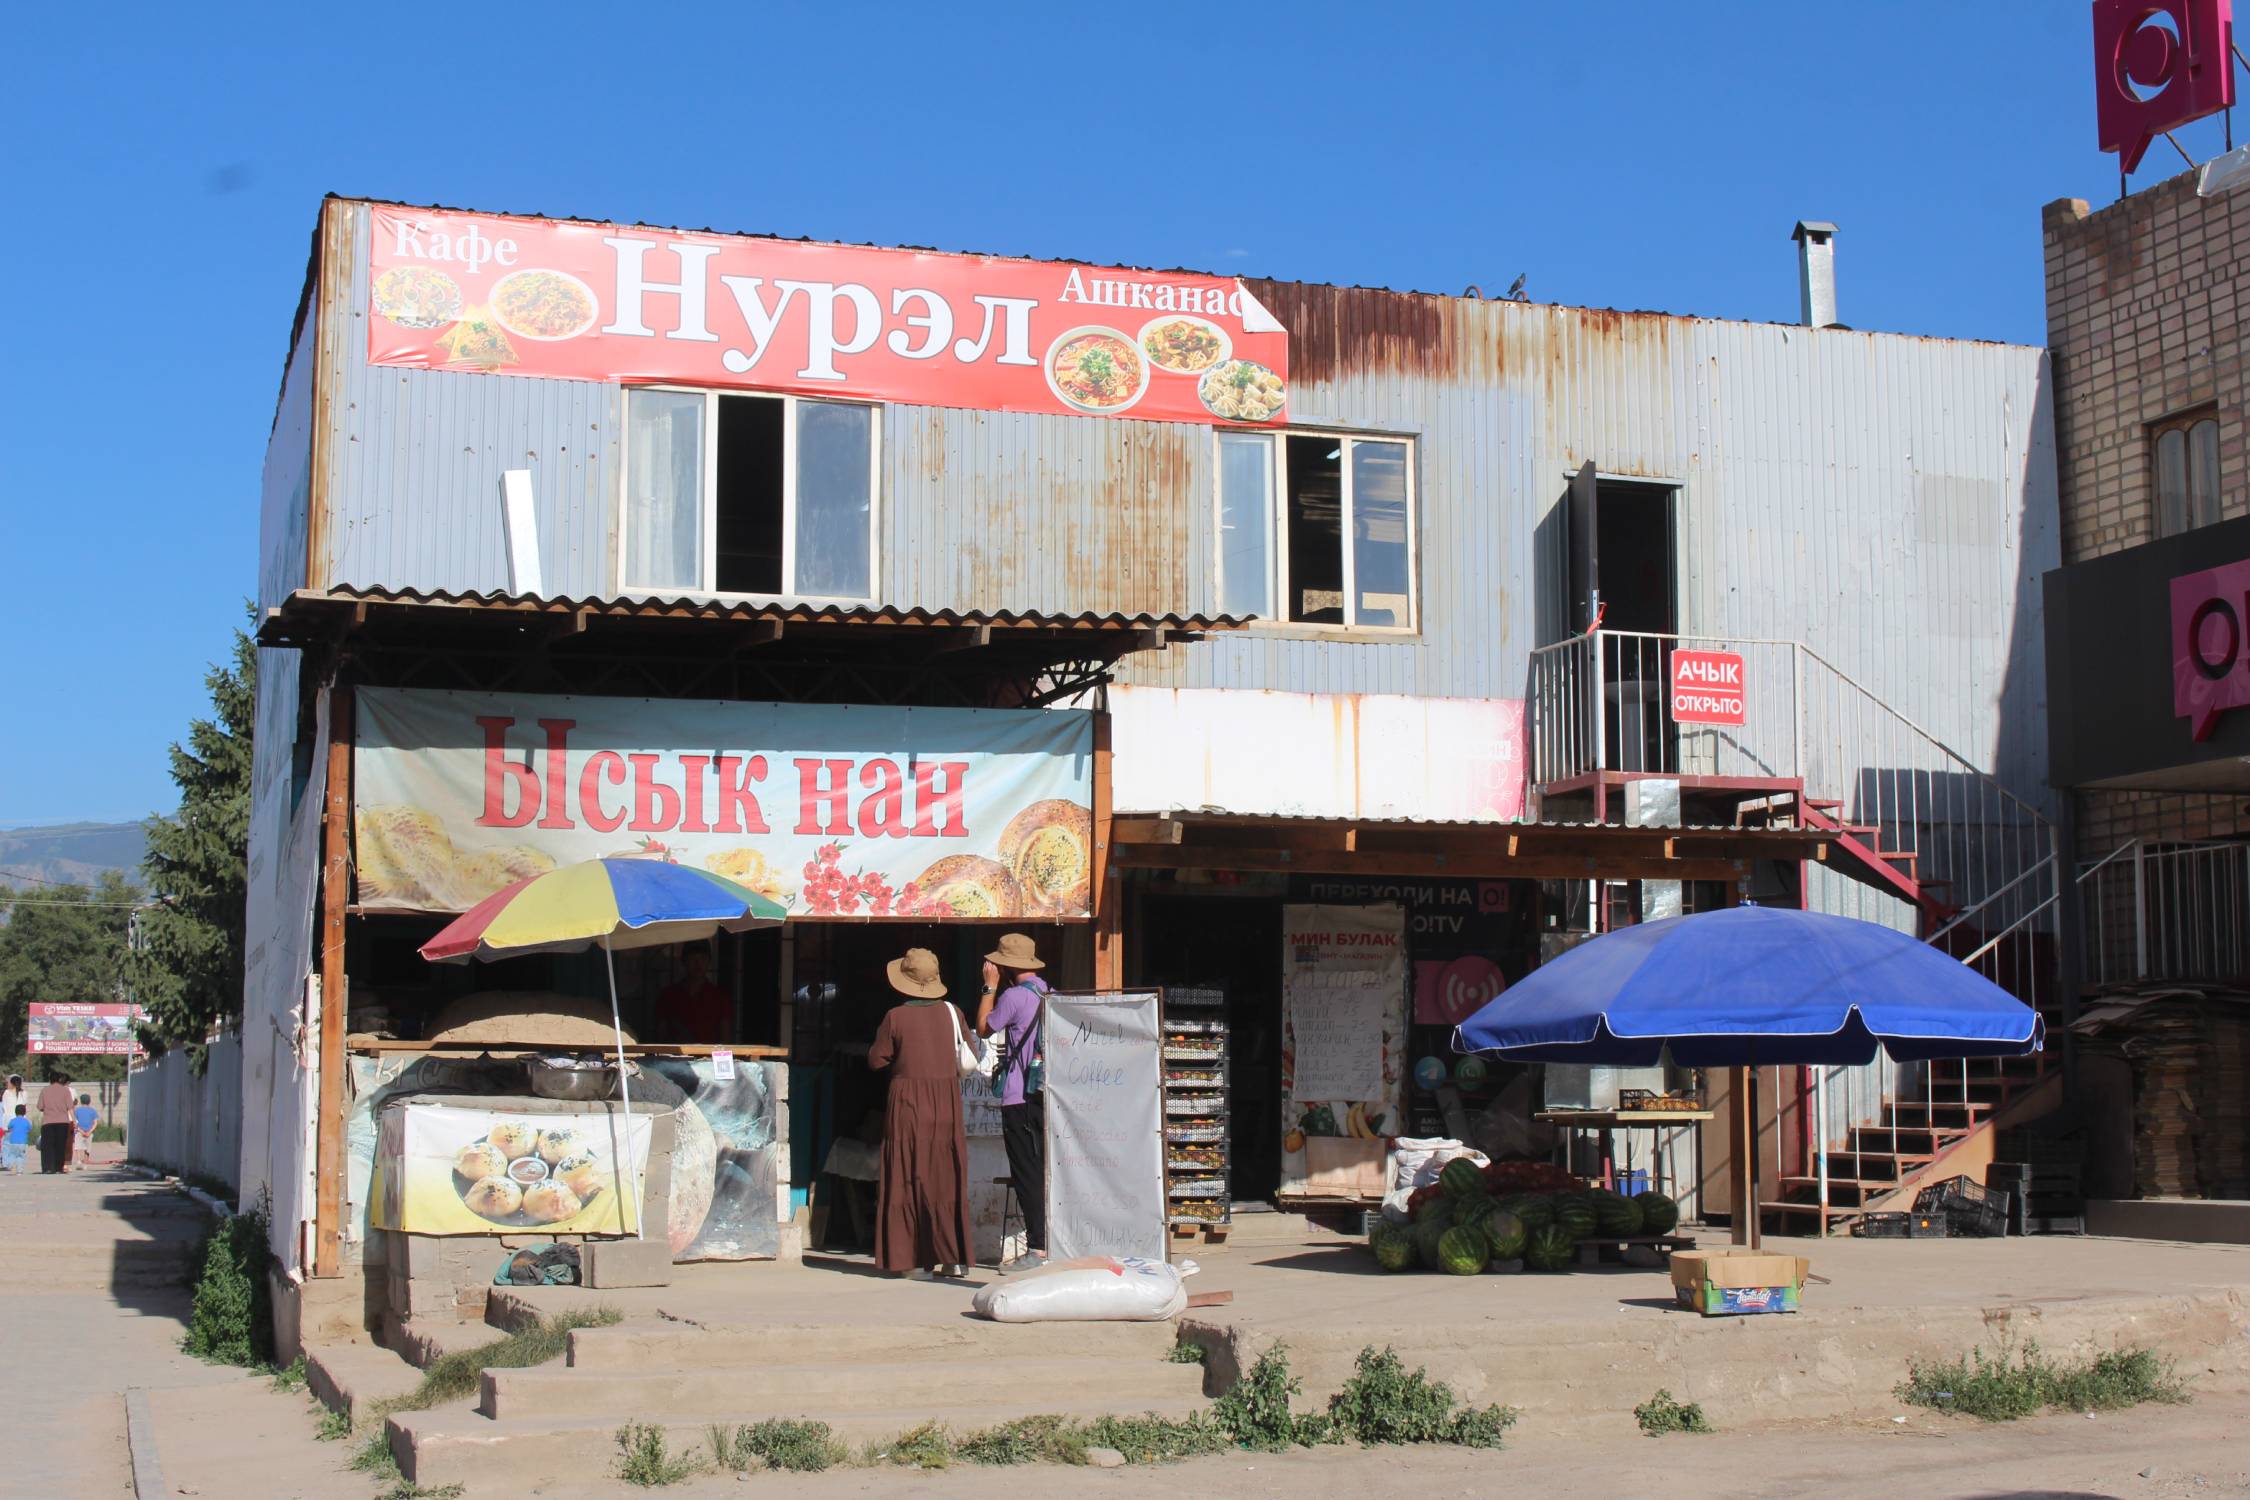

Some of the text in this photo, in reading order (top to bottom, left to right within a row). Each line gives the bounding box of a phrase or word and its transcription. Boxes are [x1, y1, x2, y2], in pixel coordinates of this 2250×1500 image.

[393, 221, 519, 273] Кафе
[601, 237, 1039, 381] Нурэл
[1677, 660, 1739, 684] АЧЫК
[1675, 695, 1742, 715] ОТКРЫТО
[474, 715, 969, 838] Ысык нан
[1441, 888, 1472, 904] НА
[1291, 933, 1396, 946] МИН БУЛАК
[1068, 1056, 1125, 1091] Coffee
